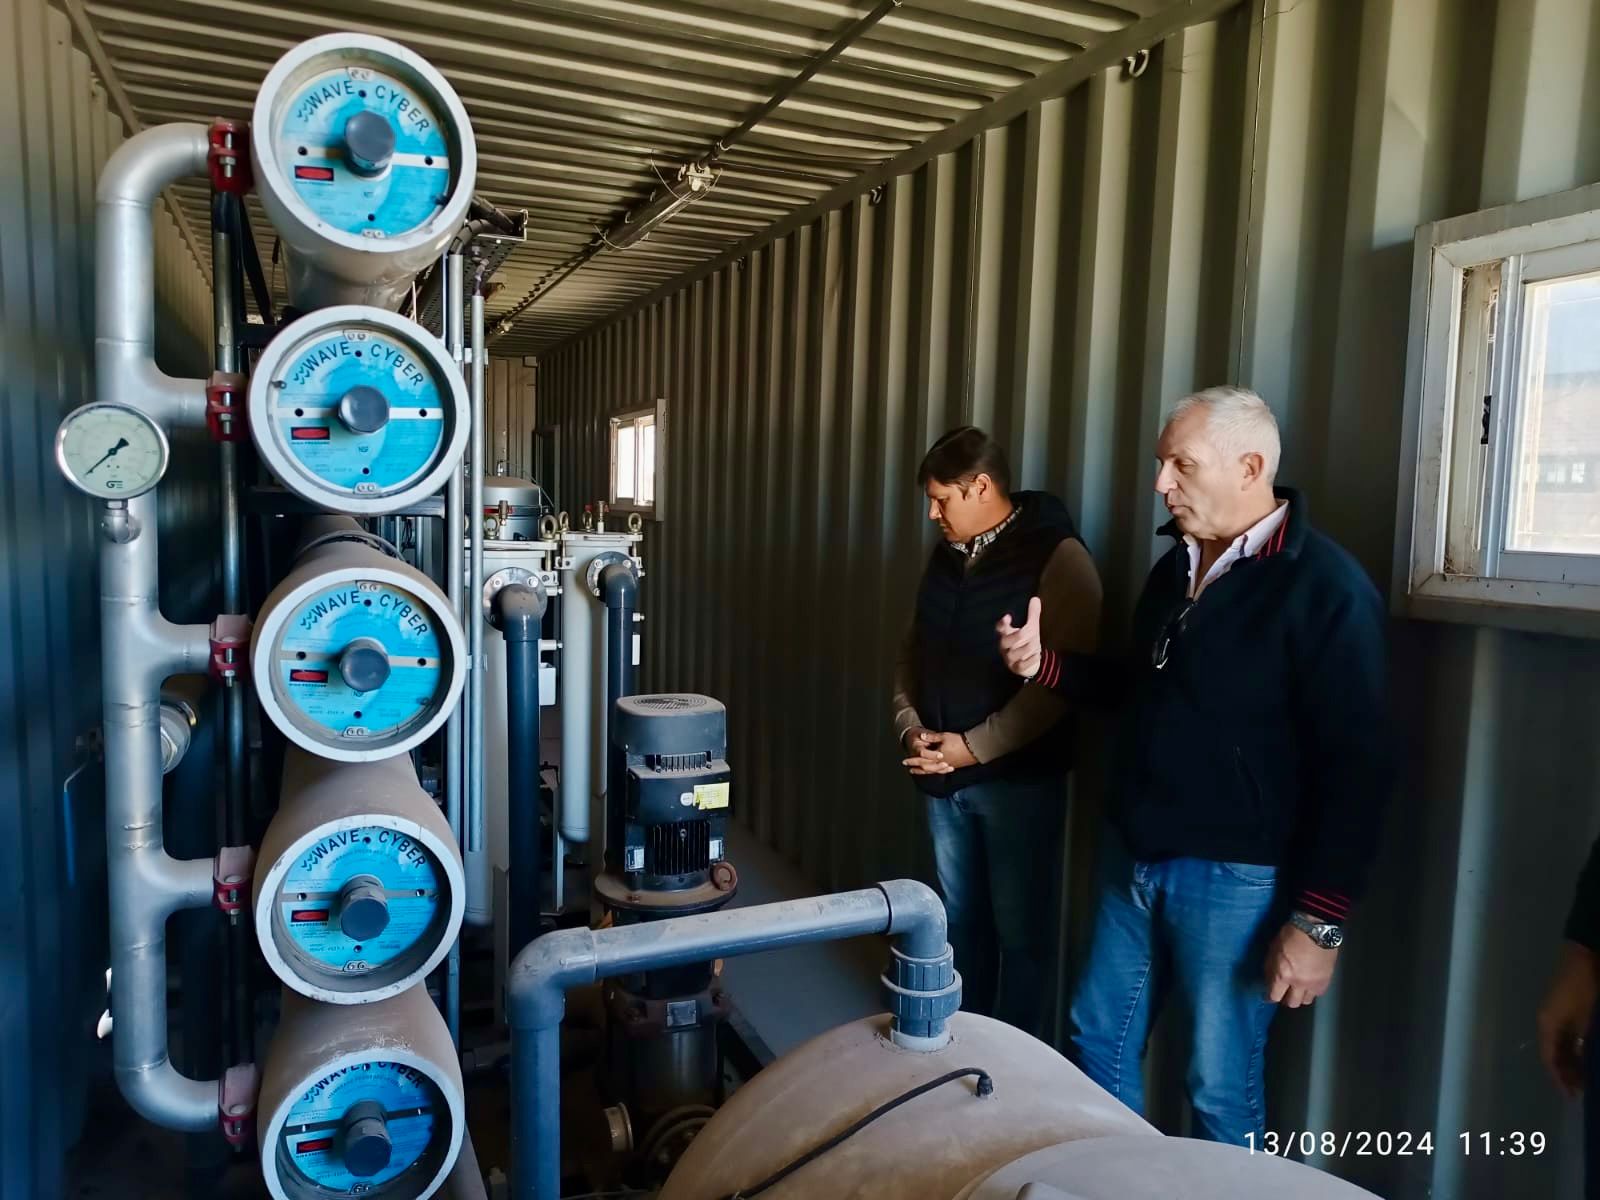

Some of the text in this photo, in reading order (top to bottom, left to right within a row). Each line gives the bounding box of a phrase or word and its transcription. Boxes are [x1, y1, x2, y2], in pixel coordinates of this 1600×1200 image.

[308, 81, 430, 132] WAVE CYBER
[305, 341, 424, 386] WAVE CYBER
[312, 591, 428, 636] WAVE CYBER
[311, 831, 360, 859] WAVE
[378, 831, 426, 869] CYBER
